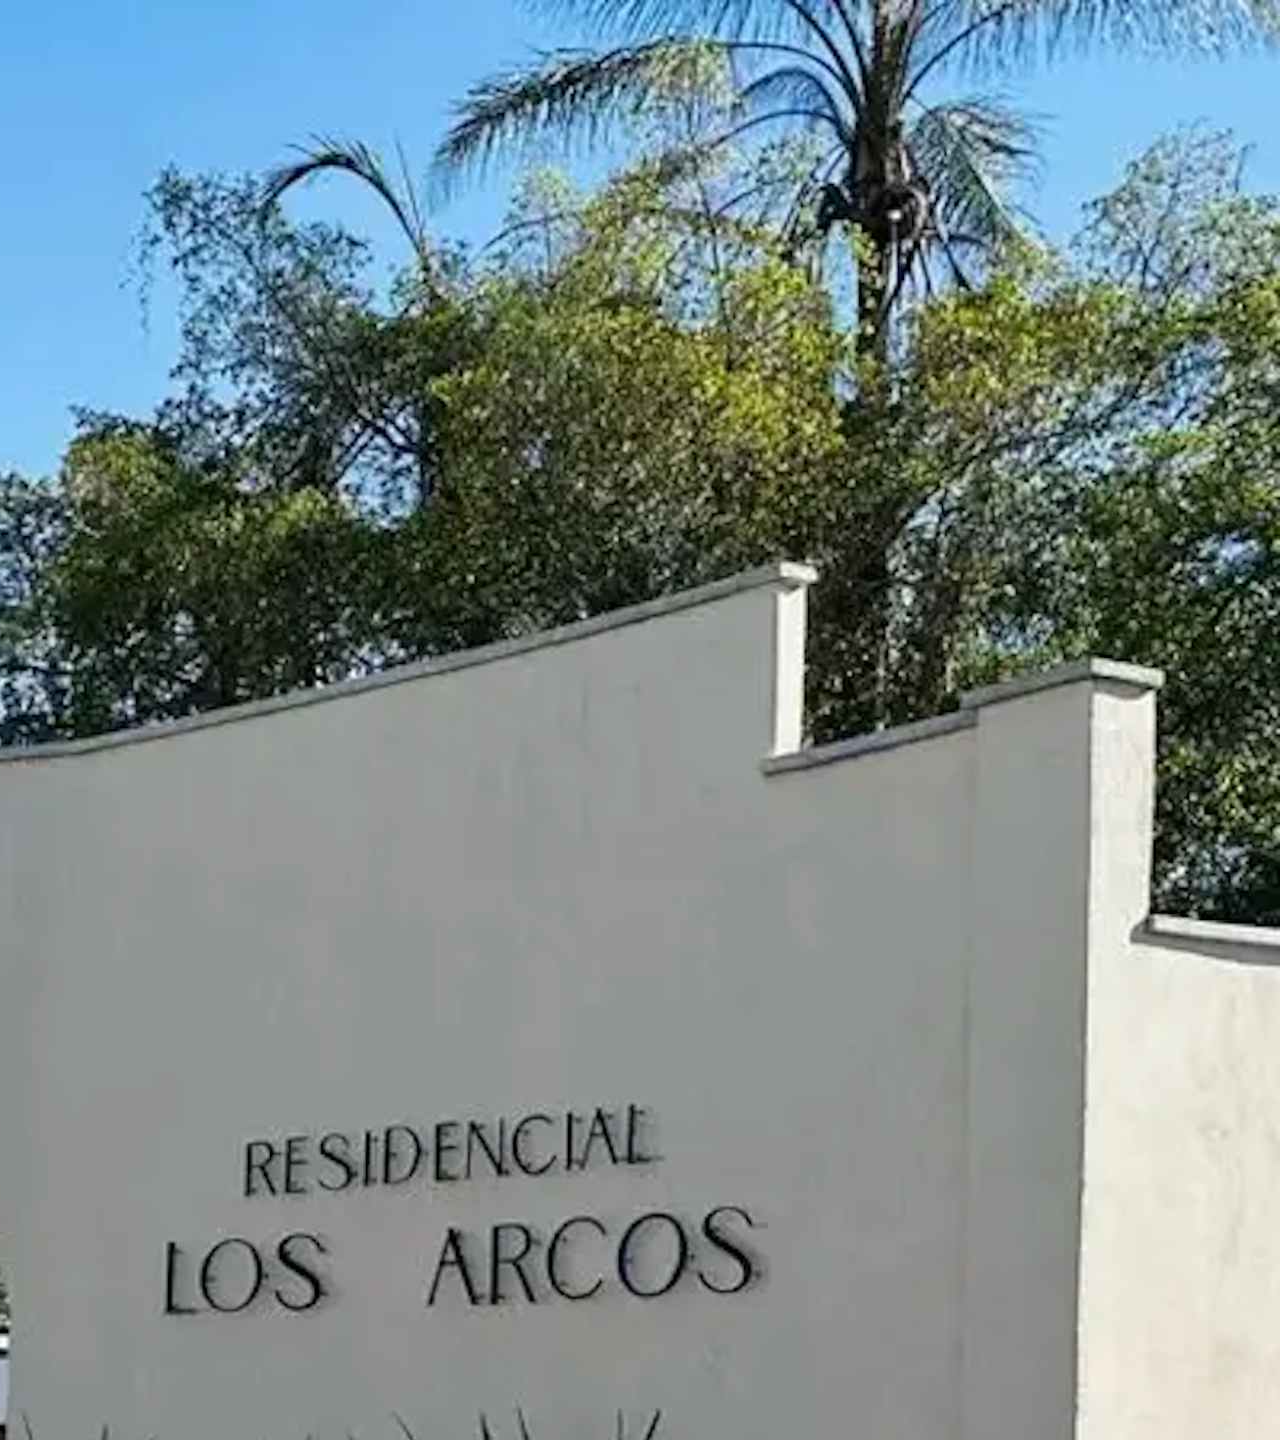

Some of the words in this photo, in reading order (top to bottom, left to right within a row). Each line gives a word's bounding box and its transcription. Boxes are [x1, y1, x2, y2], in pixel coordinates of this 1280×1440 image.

[243, 1104, 655, 1197] RESIDENCIAL
[162, 1231, 329, 1316] LOS
[425, 1206, 764, 1308] ARCOS
